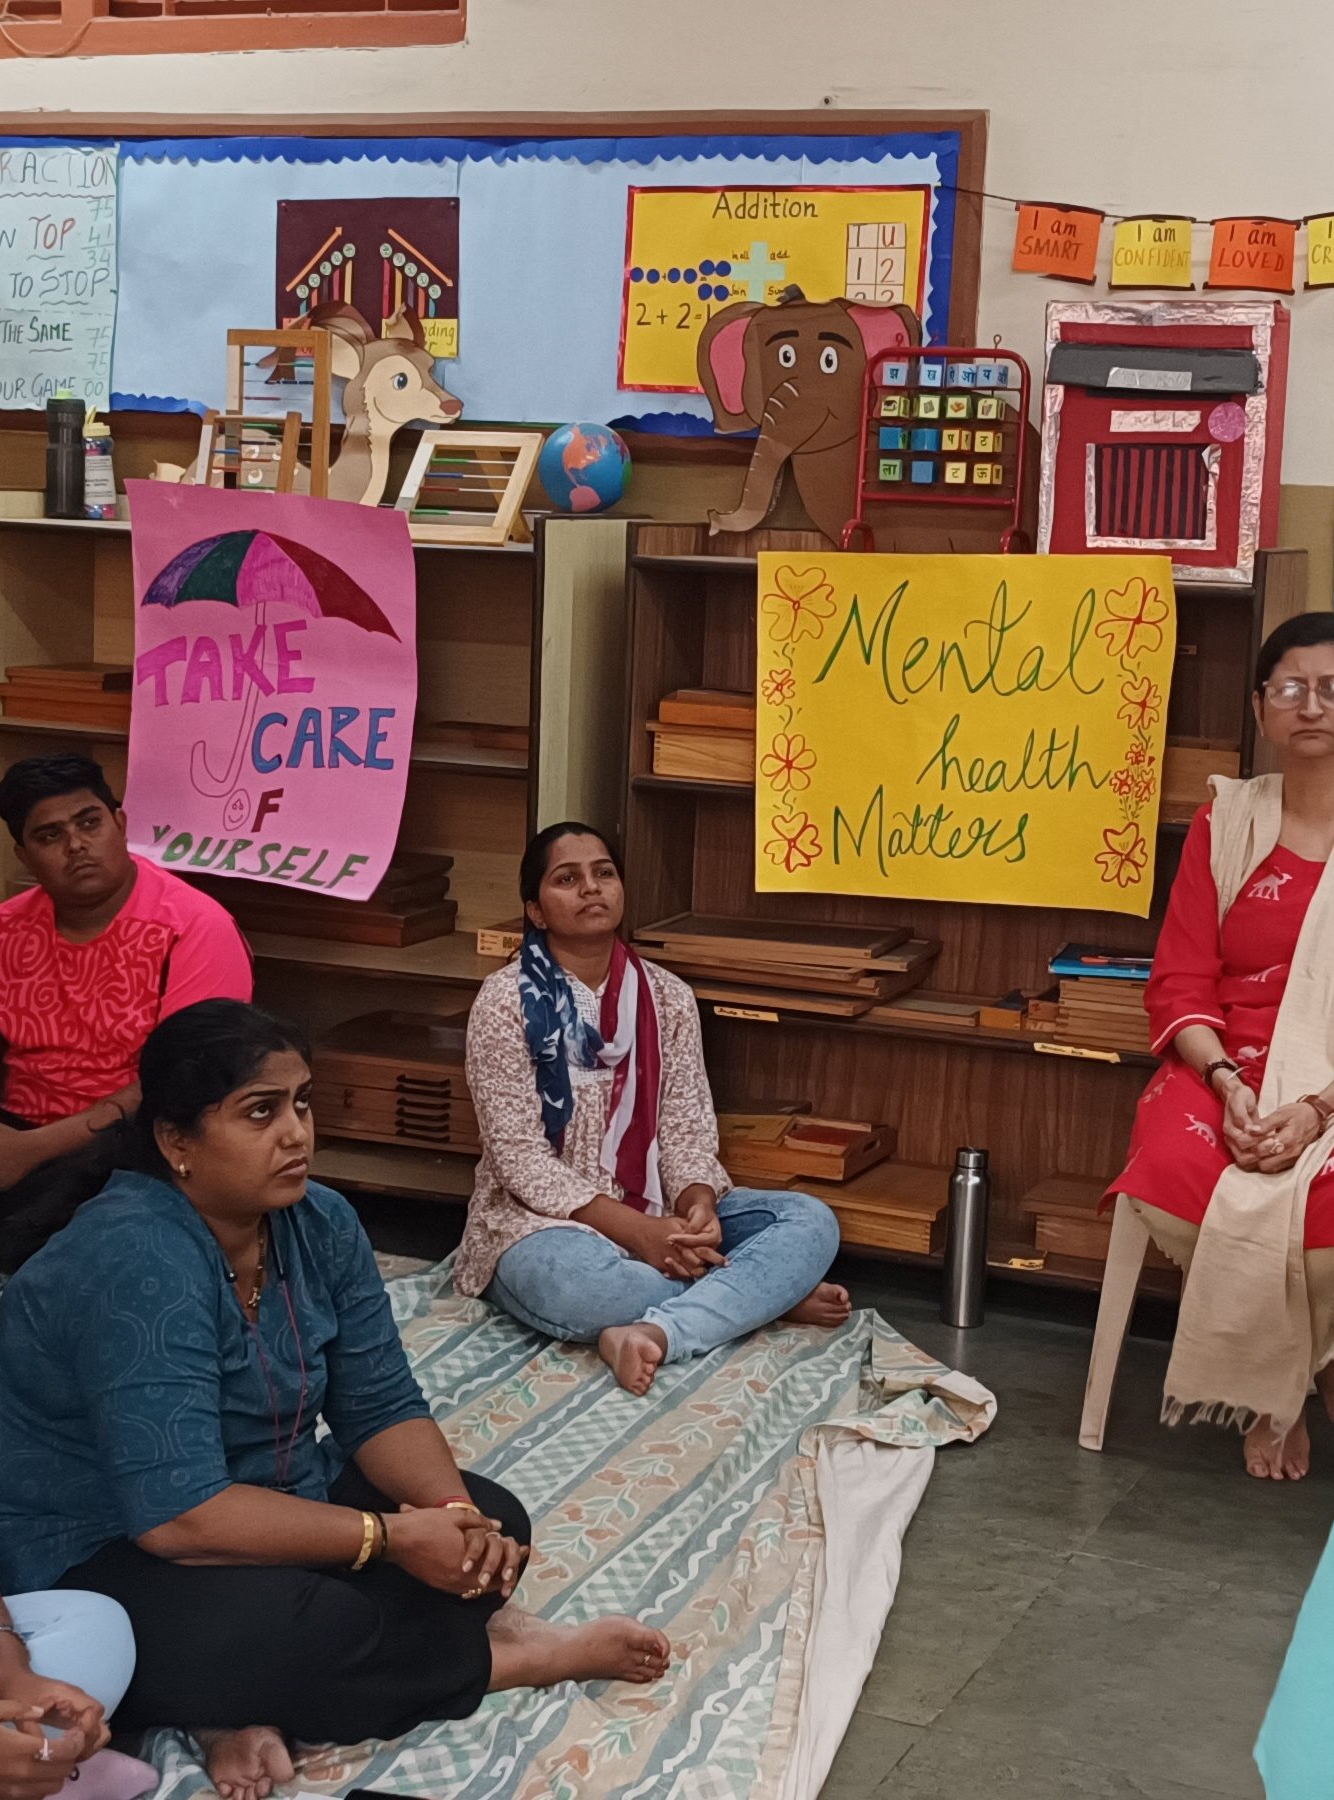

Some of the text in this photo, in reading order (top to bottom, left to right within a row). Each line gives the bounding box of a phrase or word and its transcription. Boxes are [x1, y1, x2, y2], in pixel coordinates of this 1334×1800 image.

[712, 192, 818, 220] Addition
[28, 214, 76, 251] TOP
[1032, 210, 1077, 238] I am
[1137, 224, 1176, 243] I am
[1229, 224, 1276, 247] I am
[1327, 221, 1333, 239] I
[1019, 236, 1083, 262] SMART
[1114, 246, 1191, 268] CONFIDENT
[1217, 248, 1285, 272] LOVED
[880, 258, 895, 283] 2
[10, 272, 33, 298] TO
[0, 319, 24, 344] THE
[27, 315, 74, 343] SAME
[636, 302, 651, 326] 2
[676, 302, 691, 329] 2
[812, 579, 1105, 705] Mental
[135, 619, 316, 707] TAKE
[251, 706, 396, 774] CARE
[917, 713, 1111, 793] health
[833, 784, 1030, 879] Matters
[151, 824, 370, 890] YOURSELF
